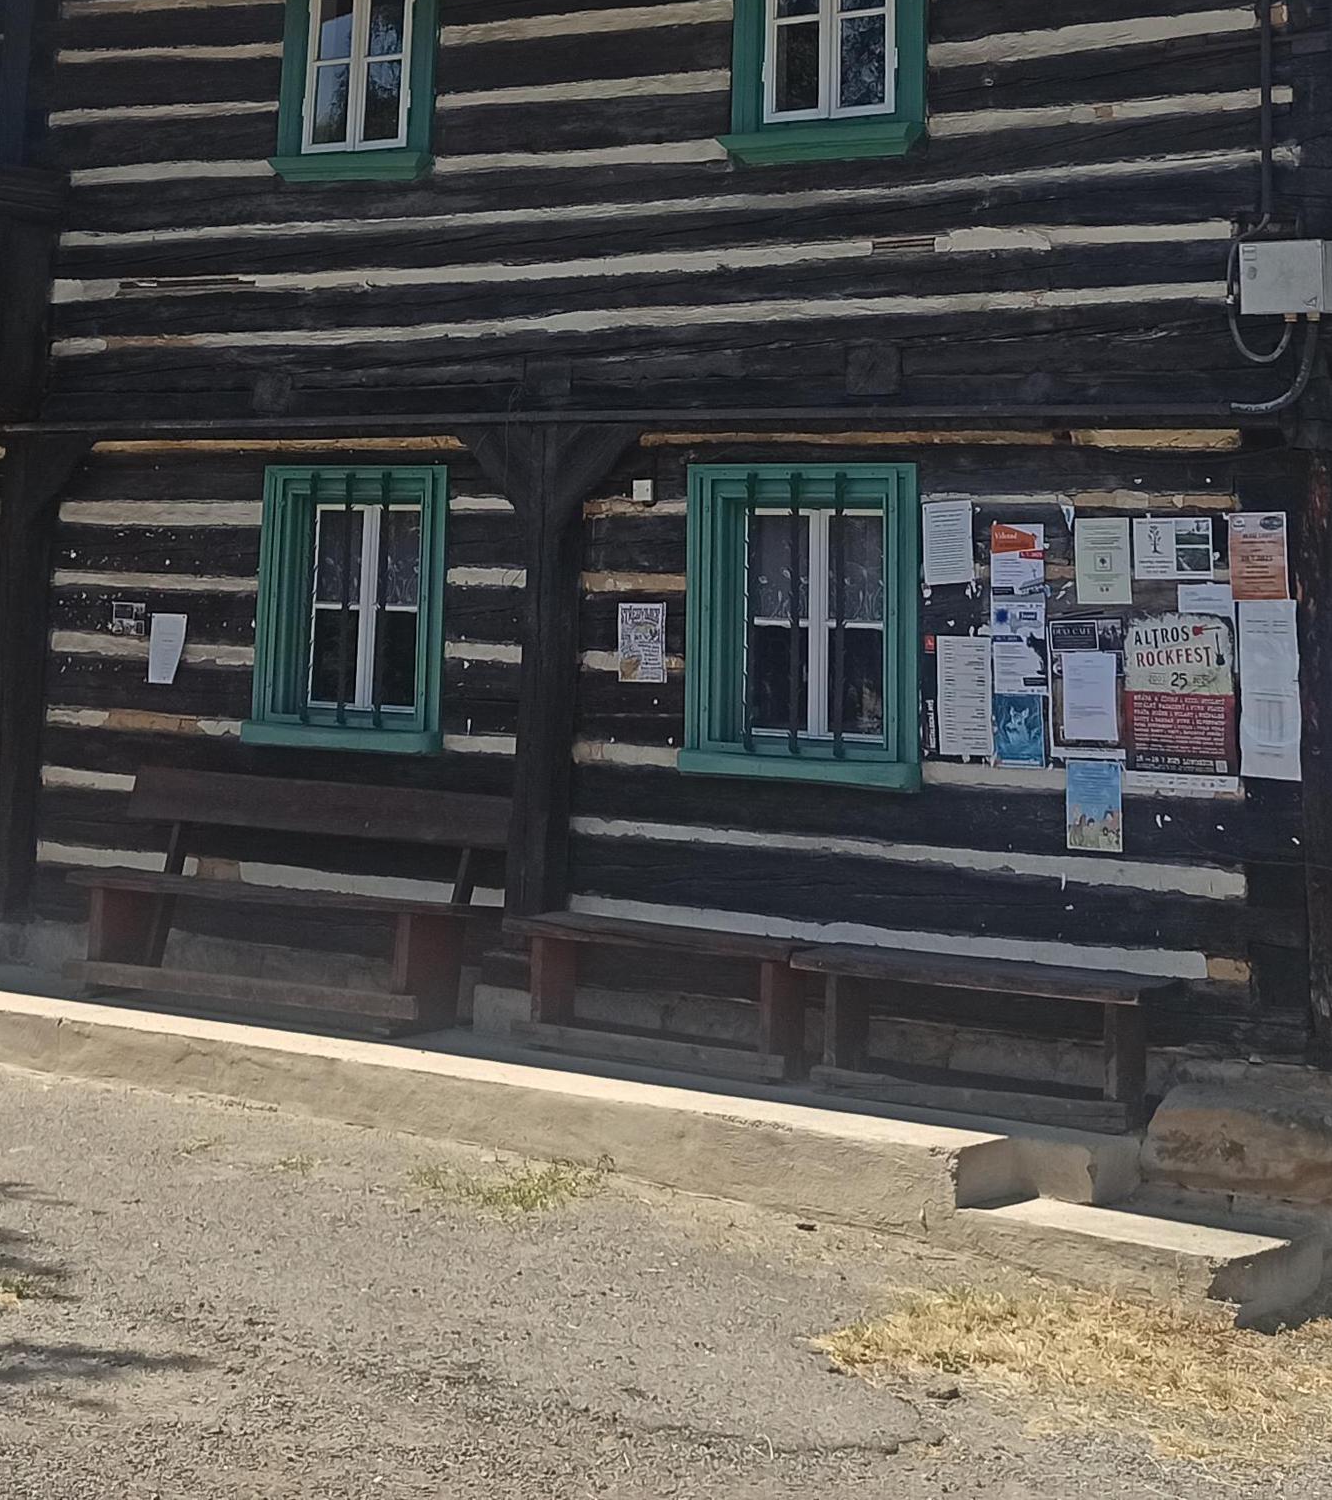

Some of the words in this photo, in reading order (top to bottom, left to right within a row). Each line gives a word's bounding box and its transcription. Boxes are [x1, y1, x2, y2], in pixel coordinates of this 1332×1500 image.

[1134, 625, 1190, 648] ALTROS
[1136, 646, 1211, 667] ROCKFEST
[1171, 672, 1188, 690] 25
